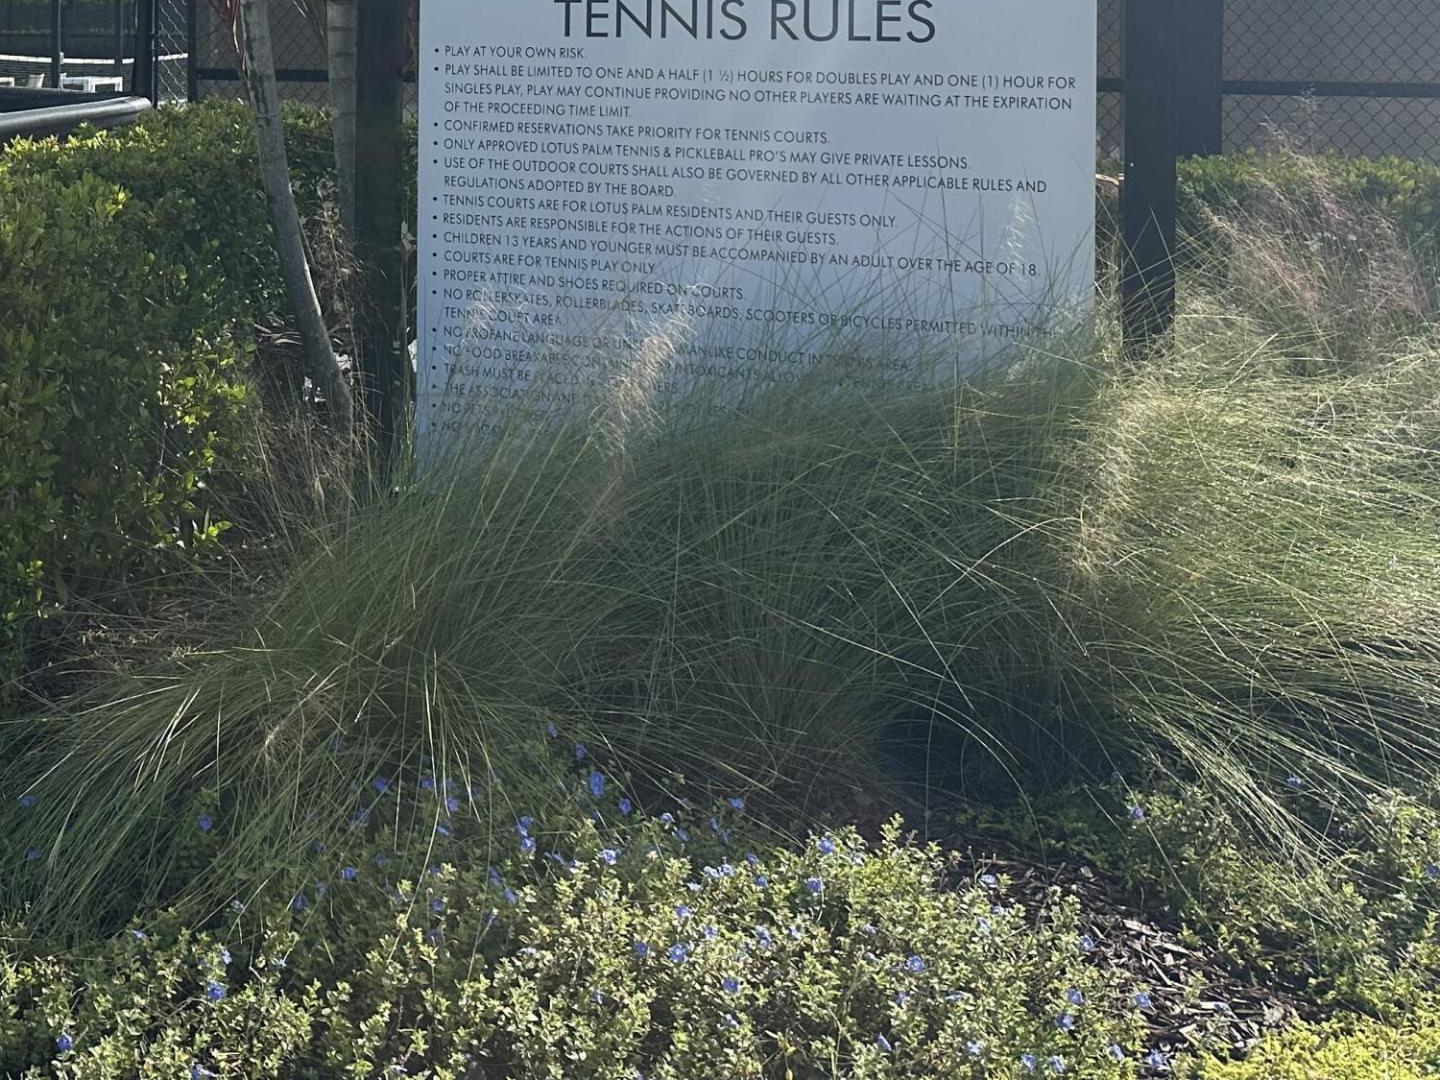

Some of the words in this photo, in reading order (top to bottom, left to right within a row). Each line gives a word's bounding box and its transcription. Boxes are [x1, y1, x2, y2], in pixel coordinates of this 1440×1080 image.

[444, 45, 470, 57] PLAY
[472, 46, 486, 57] AT
[489, 46, 522, 58] YOUR
[524, 47, 556, 59] OWN
[444, 64, 471, 76] PLAY
[472, 65, 508, 77] SHALL
[509, 65, 524, 77] BE
[526, 66, 573, 78] LIMITED
[575, 67, 593, 78] TO
[594, 67, 623, 79] ONE
[625, 68, 654, 80] AND
[656, 69, 665, 80] A
[667, 69, 699, 81] HALF
[736, 70, 783, 82] HOURS
[785, 71, 812, 83] FOR
[815, 72, 877, 84] DOUBLES
[879, 73, 910, 85] PLAY
[912, 74, 944, 86] AND
[946, 75, 978, 87] ONE
[981, 75, 999, 89] (1)
[1002, 76, 1044, 88] HOUR
[1046, 77, 1076, 89] FOR
[443, 102, 460, 113] OF
[463, 102, 484, 114] THE
[486, 103, 566, 116] PROCEEDING
[568, 105, 596, 117] TIME
[444, 82, 492, 95] SINGLES
[493, 84, 523, 98] PLAY,
[526, 85, 553, 96] PLAY
[555, 85, 581, 97] MAY
[583, 86, 651, 99] CONTINUE
[653, 88, 726, 101] PROVIDING
[728, 90, 751, 102] NO
[753, 91, 797, 103] OTHER
[799, 92, 852, 104] PLAYERS
[854, 93, 879, 105] ARE
[881, 94, 942, 107] WAITING
[943, 96, 959, 107] AT
[964, 96, 989, 108] THE
[992, 97, 1072, 110] EXPIRATION
[443, 120, 514, 133] CONFIRMED
[516, 122, 603, 136] RESERVATIONS
[606, 125, 634, 137] TAKE
[637, 126, 692, 139] PRIORITY
[694, 128, 721, 140] FOR
[724, 129, 770, 142] TENNIS
[442, 138, 475, 151] ONLY
[476, 140, 538, 153] APPROVED
[540, 142, 579, 155] LOTUS
[581, 143, 613, 156] PALM
[615, 145, 660, 157] TENNIS
[662, 146, 671, 158] &
[674, 147, 745, 161] PICKLEBALL
[788, 151, 817, 163] MAY
[819, 152, 851, 164] GIVE
[853, 153, 904, 166] PRIVATE
[443, 157, 465, 169] USE
[467, 158, 485, 170] OF
[487, 159, 509, 171] THE
[511, 160, 576, 173] OUTDOOR
[577, 162, 629, 176] COURTS
[630, 165, 668, 177] SHALL
[670, 166, 705, 179] ALSO
[707, 168, 722, 180] BE
[725, 169, 799, 183] GOVERNED
[801, 172, 817, 184] BY
[819, 173, 841, 185] ALL
[844, 174, 889, 187] OTHER
[891, 176, 968, 190] APPLICABLE
[971, 179, 1013, 192] RULES
[1015, 181, 1047, 193] AND
[443, 176, 525, 190] REGULATIONS
[526, 179, 584, 193] ADOPTED
[586, 182, 601, 194] BY
[604, 183, 627, 195] THE
[442, 194, 484, 207] TENNIS
[486, 196, 535, 210] COURTS
[536, 199, 559, 211] ARE
[561, 200, 587, 212] FOR
[588, 201, 629, 214] LOTUS
[630, 203, 663, 216] PALM
[665, 205, 732, 219] RESIDENTS
[734, 208, 764, 221] AND
[766, 210, 803, 223] THEIR
[805, 212, 856, 225] GUESTS
[442, 213, 503, 227] RESIDENTS
[505, 216, 527, 228] ARE
[529, 218, 608, 233] RESPONSIBLE
[610, 222, 636, 234] FOR
[638, 223, 661, 235] THE
[664, 225, 722, 239] ACTIONS
[724, 228, 743, 240] OF
[747, 229, 783, 242] THEIR
[442, 232, 501, 246] CHILDREN
[505, 235, 519, 247] 13
[521, 236, 558, 249] YEARS
[558, 238, 587, 251] AND
[589, 240, 652, 255] YOUNGER
[654, 244, 689, 257] MUST
[691, 246, 706, 258] BE
[708, 247, 809, 263] ACCOMPANIED
[809, 252, 826, 264] BY
[828, 253, 848, 266] AN
[850, 255, 894, 268] ADULT
[896, 257, 933, 270] OVER
[936, 259, 961, 272] THE
[963, 261, 993, 274] AGE
[995, 263, 1017, 275] OF
[443, 250, 491, 264] COURTS
[491, 253, 515, 266] ARE
[516, 255, 542, 267] FOR
[545, 256, 588, 270] TENNIS
[589, 259, 619, 272] PLAY
[442, 268, 487, 282] PROPER
[488, 271, 526, 285] ATTIRE
[527, 274, 555, 287] AND
[557, 276, 599, 290] SHOES
[601, 279, 664, 294] REQUIRED
[666, 283, 687, 296] ON
[442, 289, 463, 301] NO
[744, 308, 815, 324] SCOOTERS
[904, 319, 977, 335] PERMITTED
